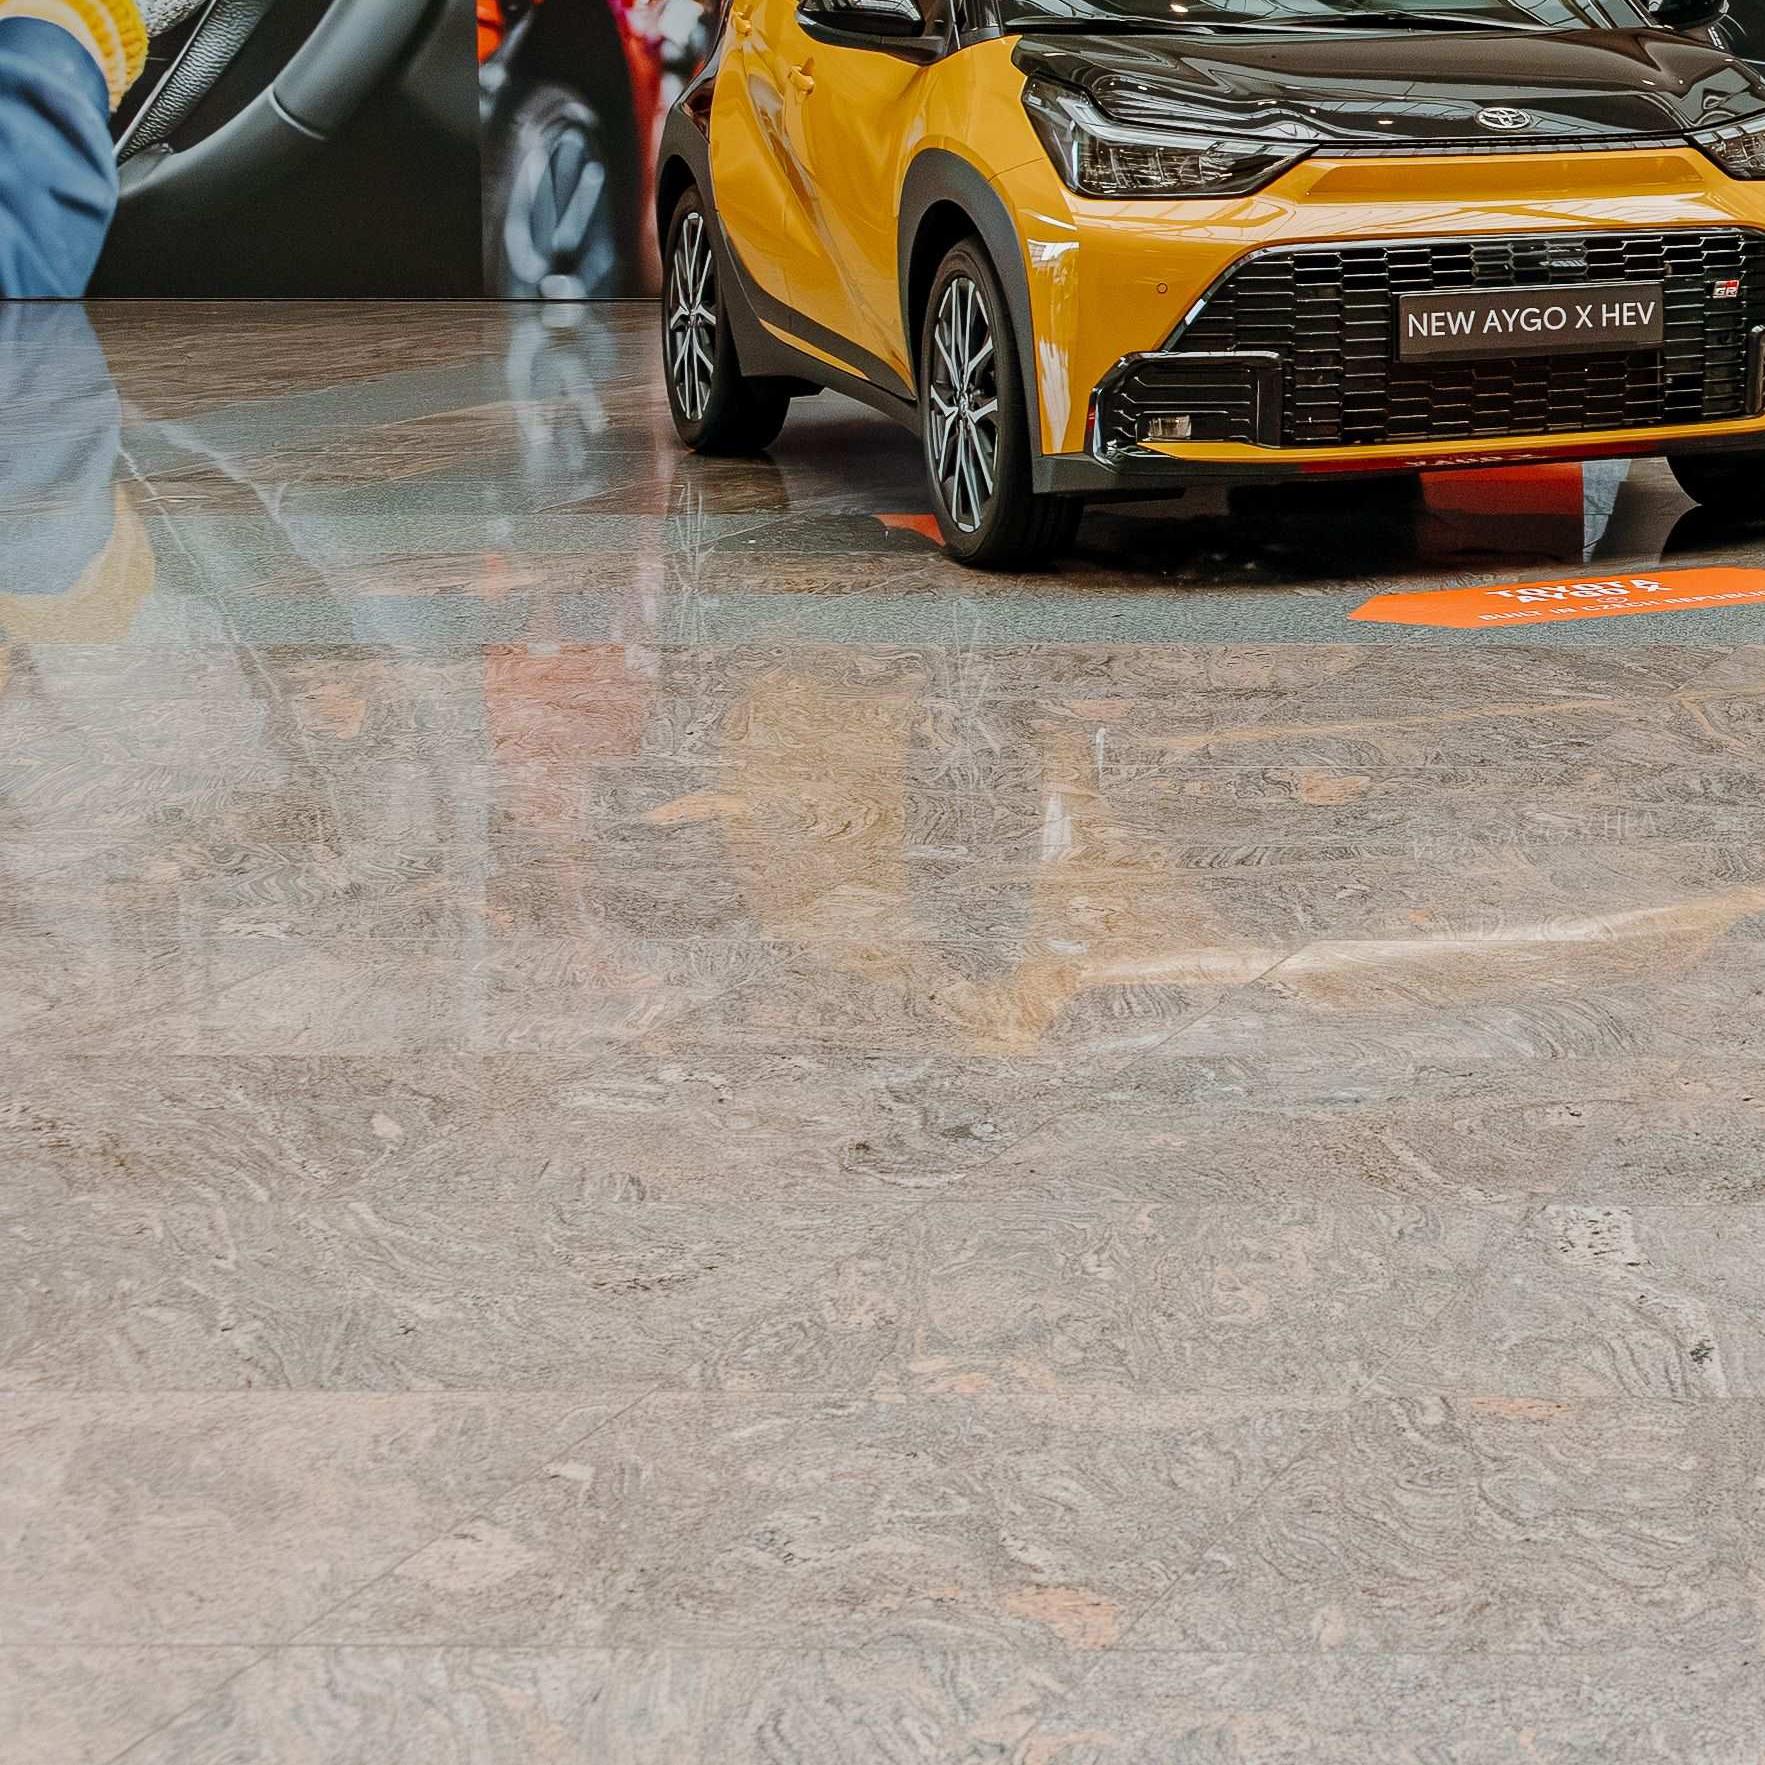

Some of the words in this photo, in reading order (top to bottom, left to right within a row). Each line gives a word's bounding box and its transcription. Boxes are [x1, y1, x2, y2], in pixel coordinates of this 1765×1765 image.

[1408, 310, 1476, 337] NEW
[1482, 307, 1567, 334] AYGO
[1575, 304, 1593, 329] X
[1601, 301, 1656, 327] HEV
[1486, 579, 1663, 597] TOYOTA
[1516, 589, 1631, 603] AYGO
